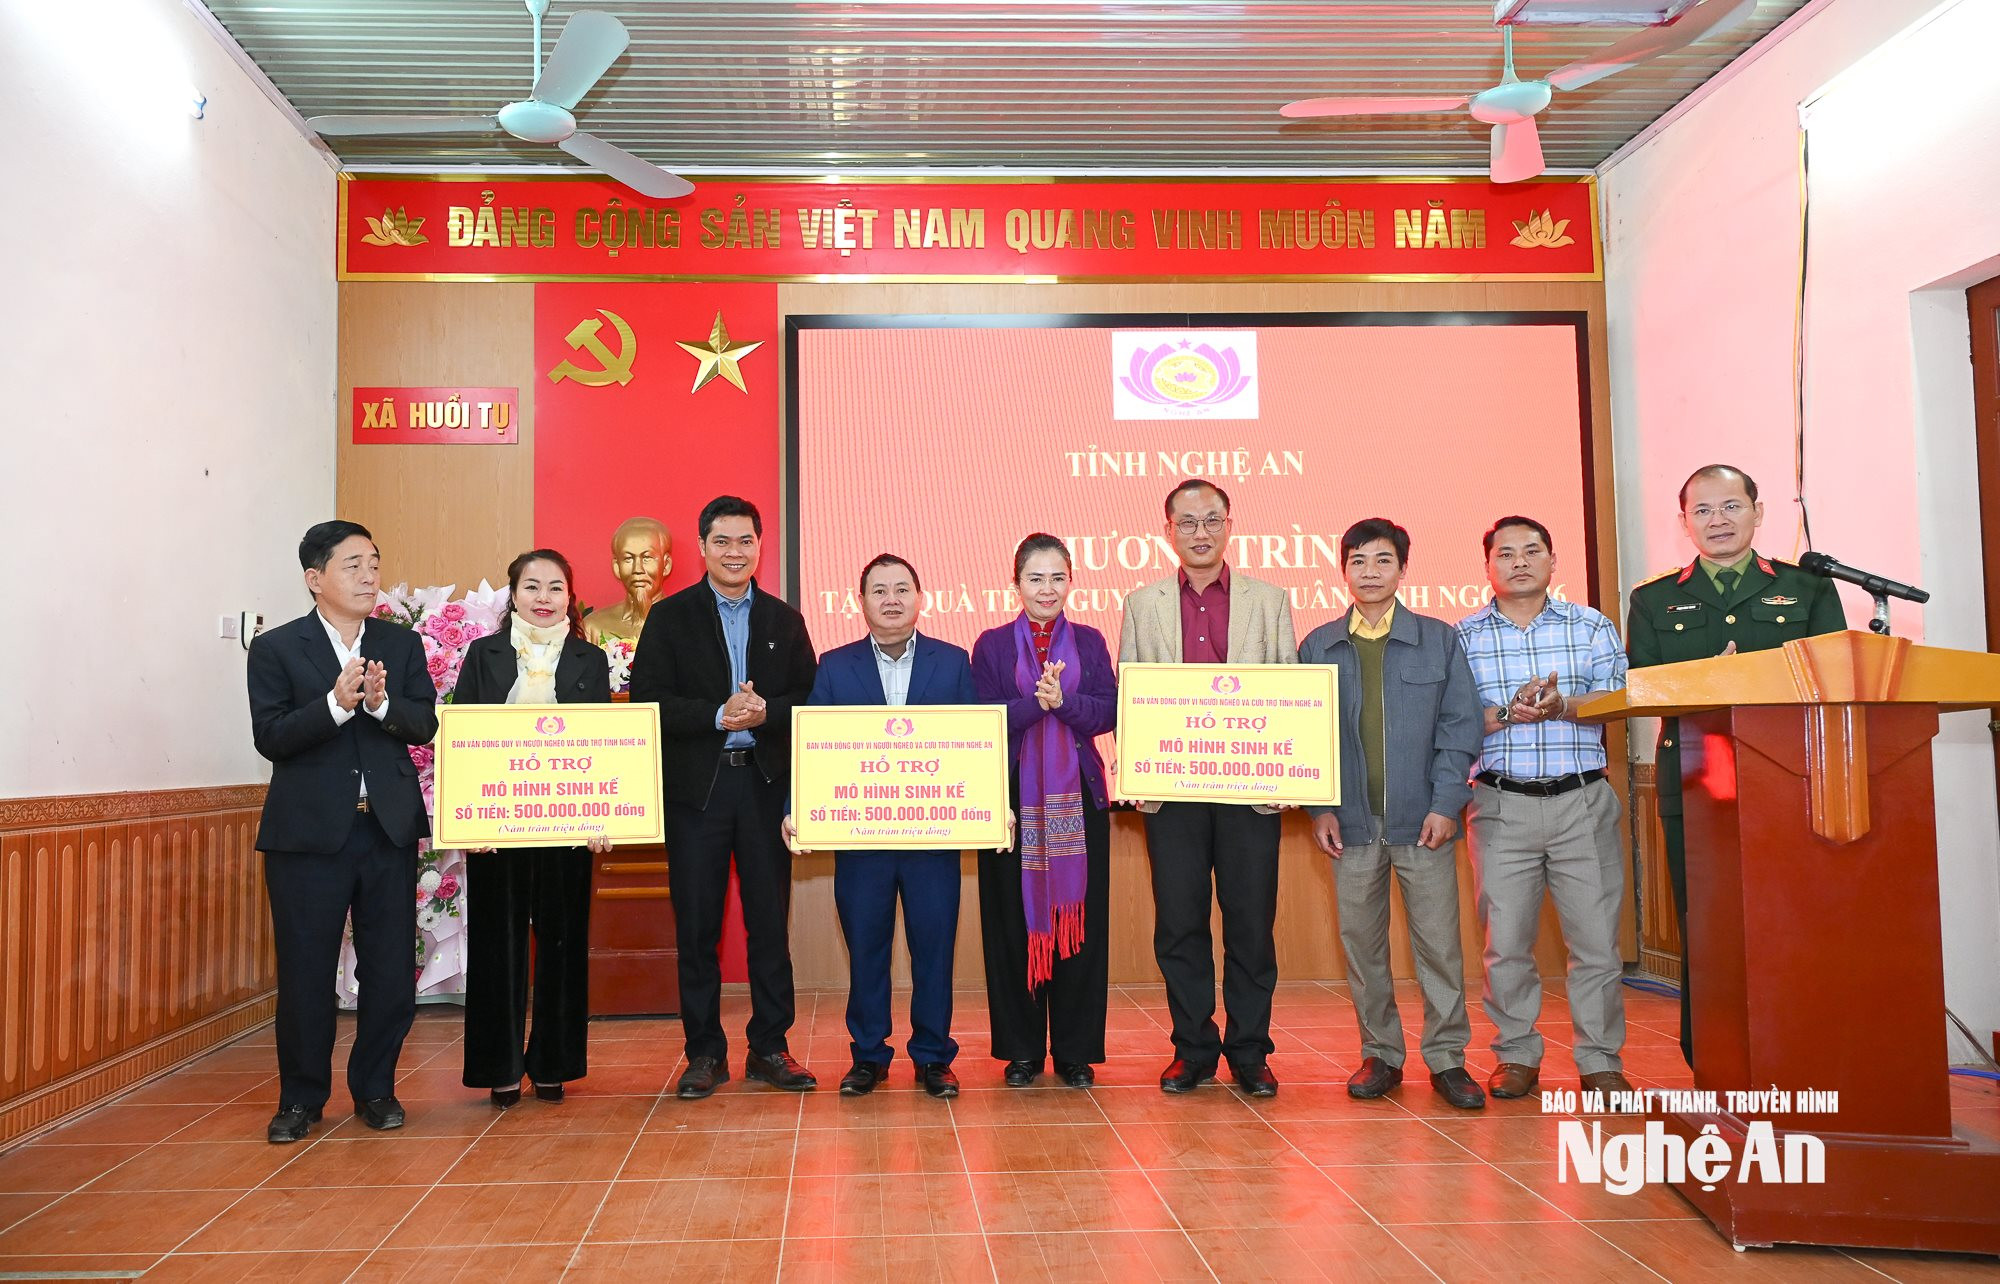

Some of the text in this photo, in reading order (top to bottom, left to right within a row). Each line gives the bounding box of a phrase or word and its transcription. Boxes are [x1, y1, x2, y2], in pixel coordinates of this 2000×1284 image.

[448, 190, 1486, 257] ĐẢNG CỘNG SẢN VIỆT NAM QUANG VINH MUÔN NĂM
[362, 397, 397, 428] XÃ
[478, 402, 509, 434] TỤ
[1065, 445, 1304, 482] TỈNH NGHỆ AN
[1229, 524, 1344, 569] TRÌN
[820, 588, 859, 619] TẶ
[1285, 580, 1348, 608] UÂN
[1186, 712, 1266, 733] HỖ TRỢ
[1160, 738, 1293, 755] MÔ HÌNH SINH KẾ
[509, 753, 592, 773] HỖ TRỢ
[861, 755, 939, 776] HỖ TRỢ
[1135, 760, 1150, 773] SỐ
[1190, 761, 1284, 777] 500.000.000
[482, 778, 618, 796] MÔ HÌNH SINH KẾ
[835, 781, 964, 799] MÔ HÌNH SINH KẾ
[456, 804, 472, 819] SỐ
[514, 802, 610, 818] 500.000.000
[810, 806, 826, 821] SỐ
[865, 806, 956, 821] 500.000.000
